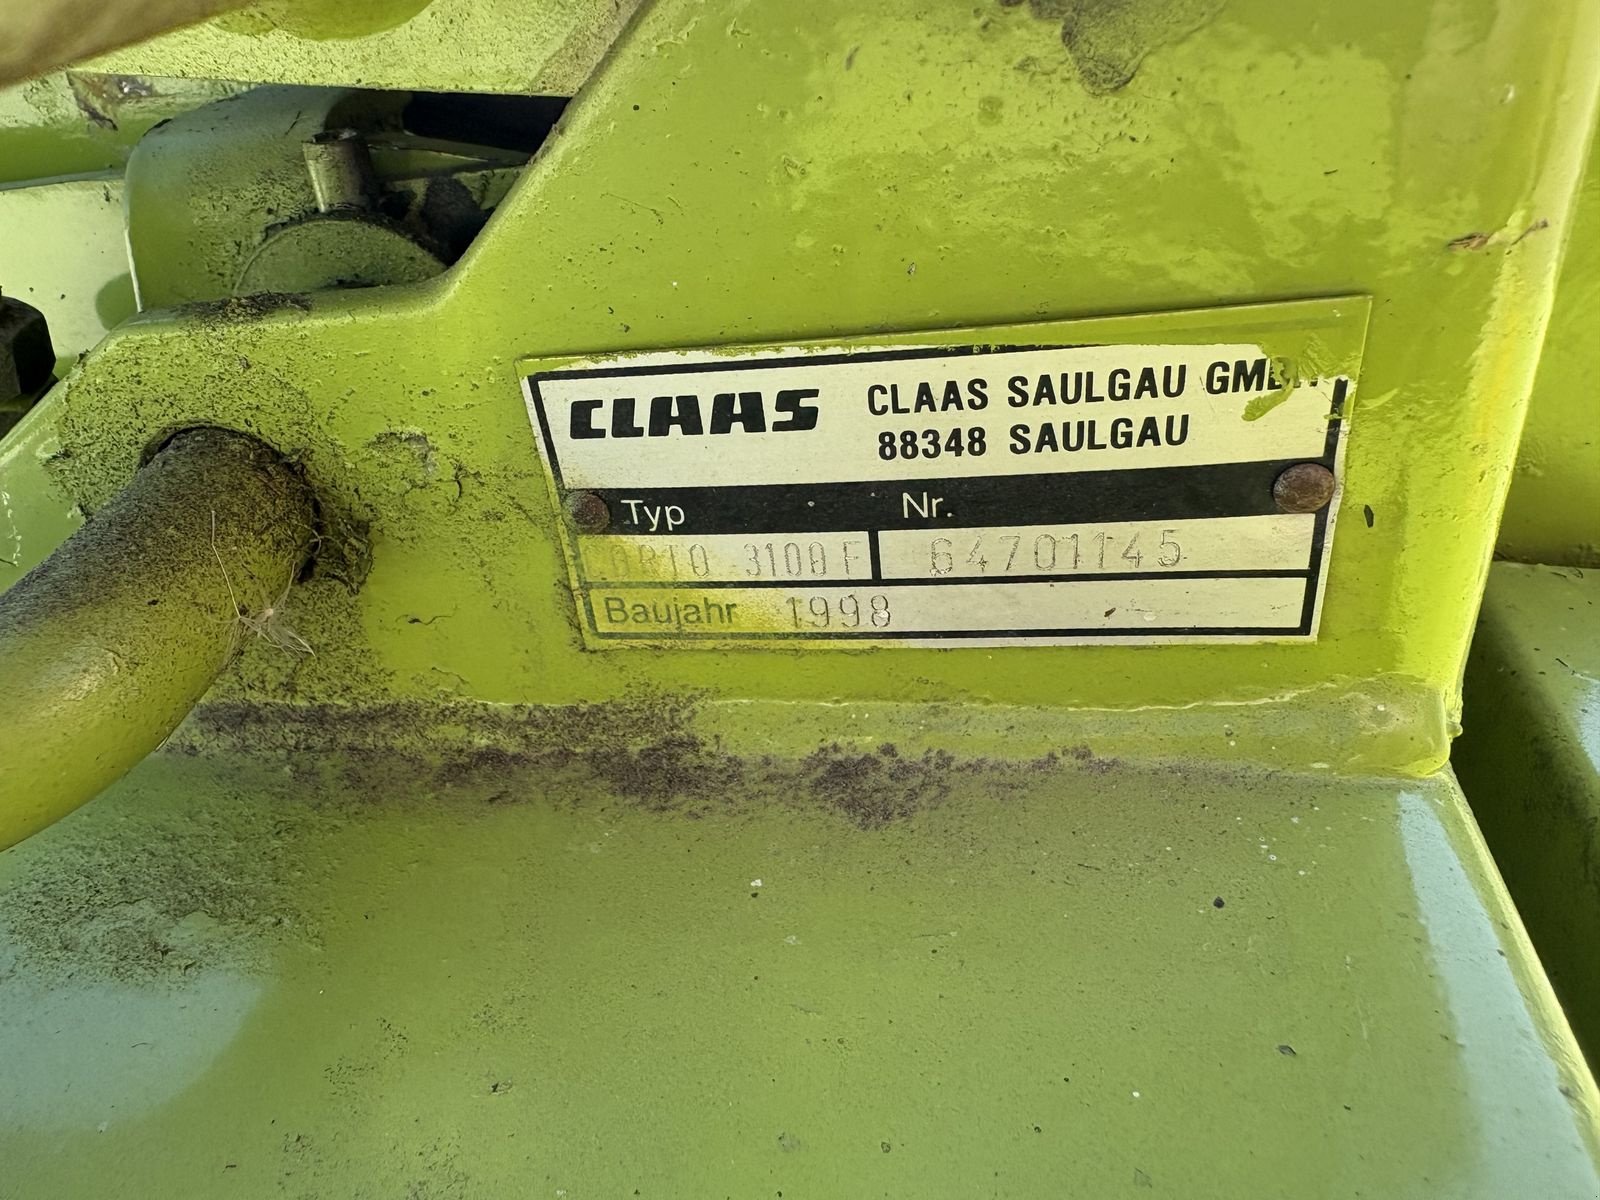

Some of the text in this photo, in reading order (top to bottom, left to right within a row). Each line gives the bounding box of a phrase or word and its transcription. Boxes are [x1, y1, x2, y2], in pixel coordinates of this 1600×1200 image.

[867, 377, 990, 416] CLAAS
[1007, 364, 1187, 408] SAULGAU
[569, 388, 820, 440] CLAAS
[878, 414, 1190, 461] 88348 SAULGAU
[620, 498, 686, 532] Typ
[902, 491, 954, 520] Nr.
[929, 528, 1182, 577] 64701145
[606, 594, 892, 634] Baujahr 1998
